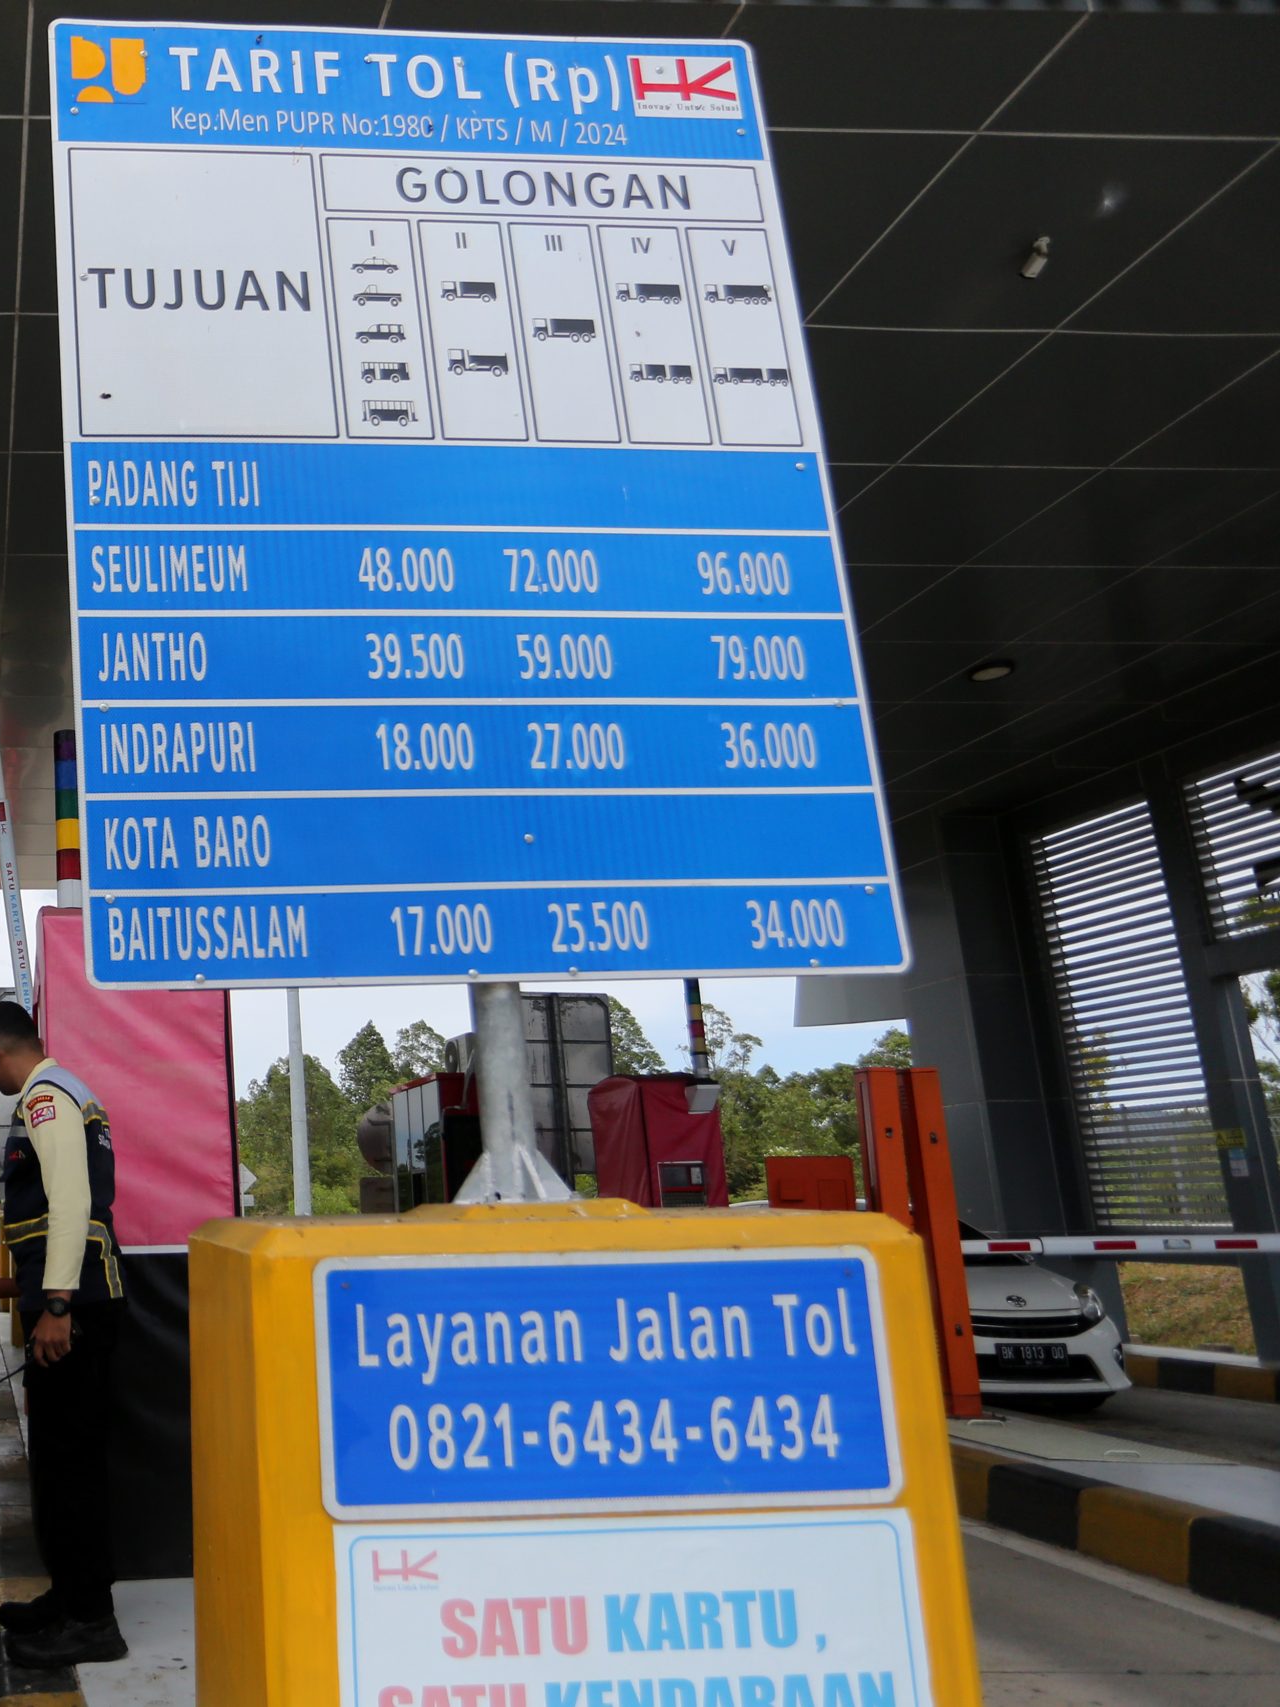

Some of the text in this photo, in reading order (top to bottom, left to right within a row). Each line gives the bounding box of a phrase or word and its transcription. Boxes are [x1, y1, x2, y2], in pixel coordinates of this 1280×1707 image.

[168, 47, 619, 115] TARIF TOL (Rp)
[276, 110, 335, 135] PUPR
[341, 112, 434, 138] No:1980
[440, 114, 449, 143] /
[456, 116, 509, 141] KPTS
[515, 117, 523, 146] /
[530, 119, 552, 142] M
[559, 118, 568, 147] /
[575, 121, 628, 146] 2024
[395, 166, 691, 210] GOLONGAN
[455, 231, 468, 250] II
[545, 234, 563, 252] III
[630, 236, 651, 254] IV
[721, 239, 736, 257] V
[87, 267, 311, 312] TUJUAN
[88, 460, 260, 507] PADANG TIJI
[91, 545, 790, 596] SEULIMEUM 48.000 72.000 96.000
[98, 632, 805, 682] JANTHO 39.500 59.000 79.000
[100, 721, 816, 775] INDRAPURI 18.000 27.000 36.000
[104, 814, 271, 870] KOTA BARO
[5, 862, 15, 890] SATU
[16, 940, 26, 969] SATU
[108, 898, 844, 962] BAITUSSALAM 17.000 25.500 34.000
[355, 1287, 857, 1385] Layanan Jalan Tol
[388, 1394, 840, 1470] 0821-6434-6434
[439, 1594, 589, 1660] SATU
[603, 1587, 799, 1654] KARTU
